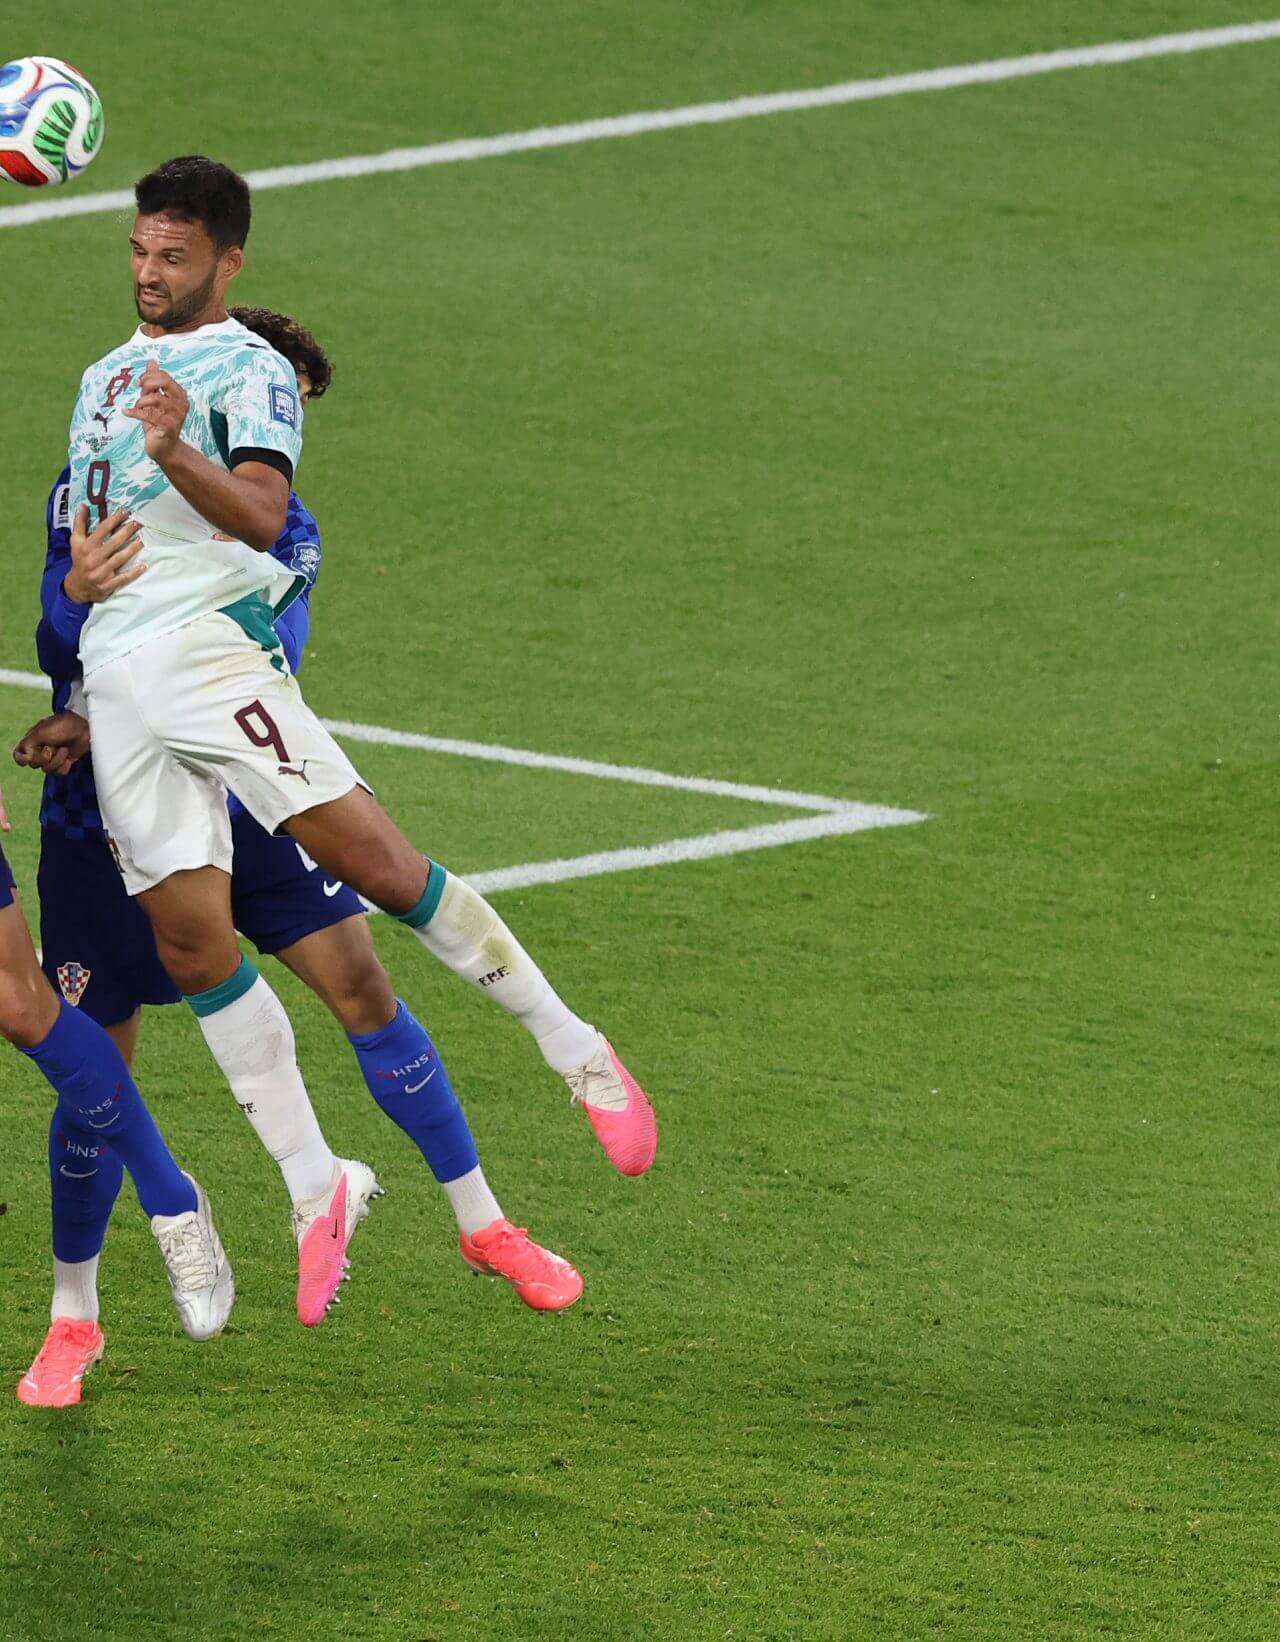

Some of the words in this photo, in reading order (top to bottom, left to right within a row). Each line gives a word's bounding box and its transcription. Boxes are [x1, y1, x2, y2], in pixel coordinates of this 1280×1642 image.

[87, 459, 110, 522] 9
[233, 699, 291, 763] 9
[392, 1053, 429, 1078] HNS
[66, 1140, 99, 1158] HNS
